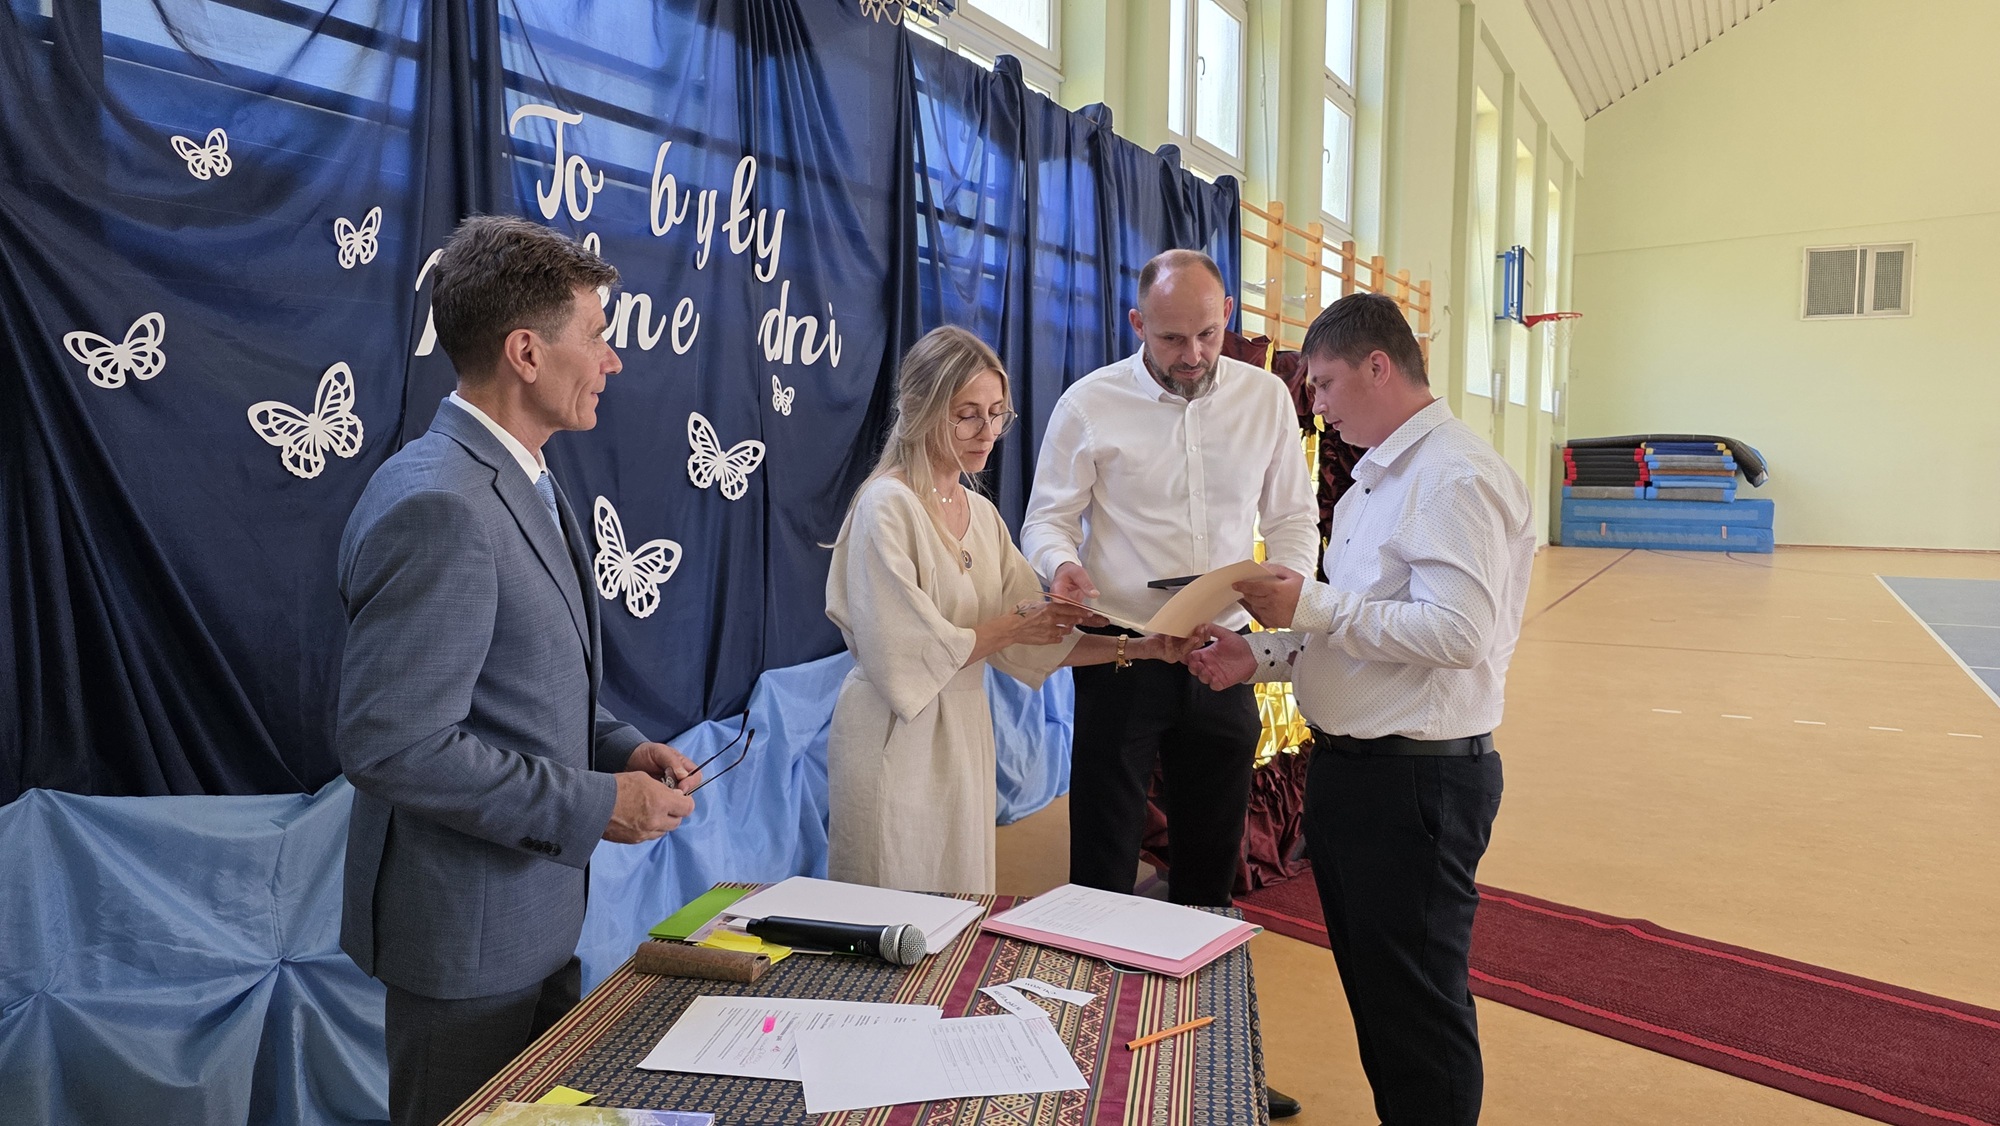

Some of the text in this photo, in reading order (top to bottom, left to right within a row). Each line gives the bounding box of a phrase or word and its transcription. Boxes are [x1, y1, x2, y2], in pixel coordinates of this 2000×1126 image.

[509, 104, 786, 283] To były
[757, 280, 842, 368] dni
